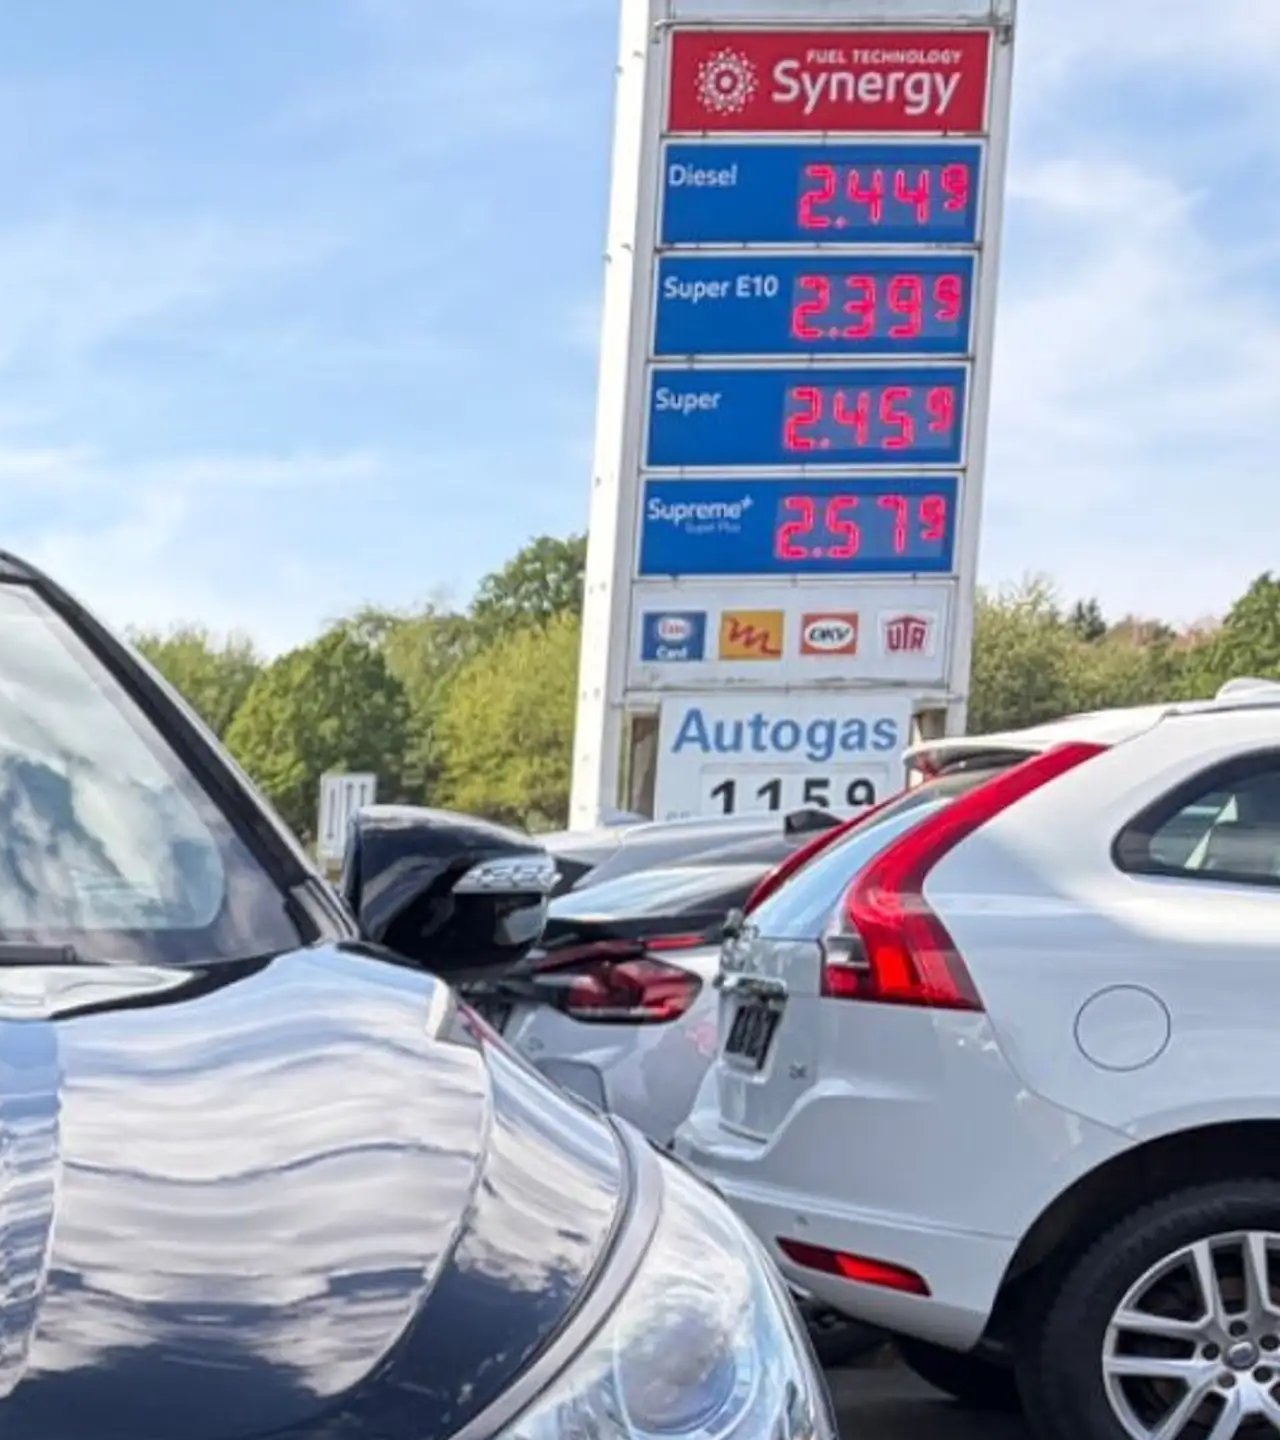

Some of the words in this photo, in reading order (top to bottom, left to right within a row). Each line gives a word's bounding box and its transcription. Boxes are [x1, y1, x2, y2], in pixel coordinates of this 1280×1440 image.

[806, 49, 847, 64] FUEL
[852, 48, 963, 65] TECHNOLOGY
[771, 58, 963, 116] Synergy
[667, 162, 738, 187] Diesel
[663, 274, 730, 304] Super
[735, 275, 780, 298] E10
[654, 387, 722, 416] Super
[670, 707, 899, 763] Autogas
